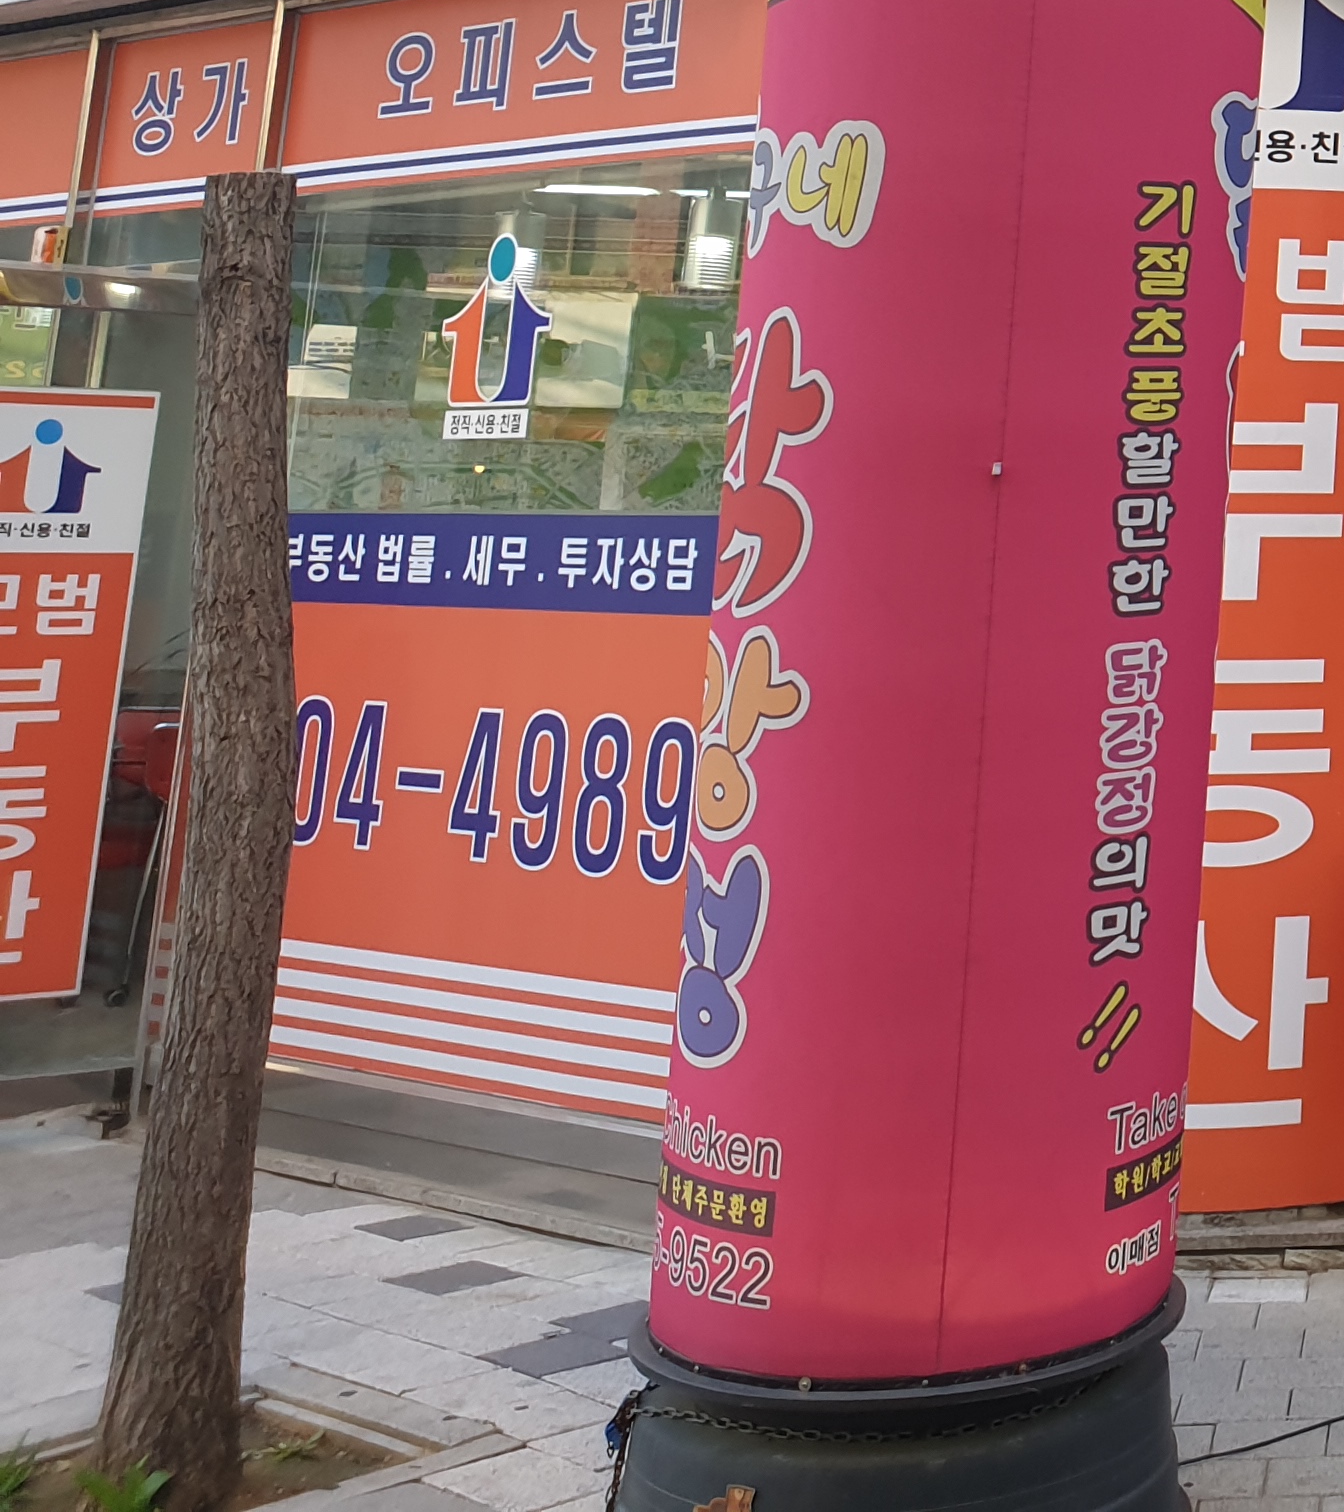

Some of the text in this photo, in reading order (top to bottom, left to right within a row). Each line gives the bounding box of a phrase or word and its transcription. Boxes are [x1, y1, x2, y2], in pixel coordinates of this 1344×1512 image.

[131, 57, 250, 158] 상가
[376, 534, 437, 583] 법률
[461, 535, 529, 586] 세무
[557, 534, 699, 592] 투자상담
[1107, 1090, 1179, 1156] Take
[1105, 1219, 1162, 1276] 이매점
